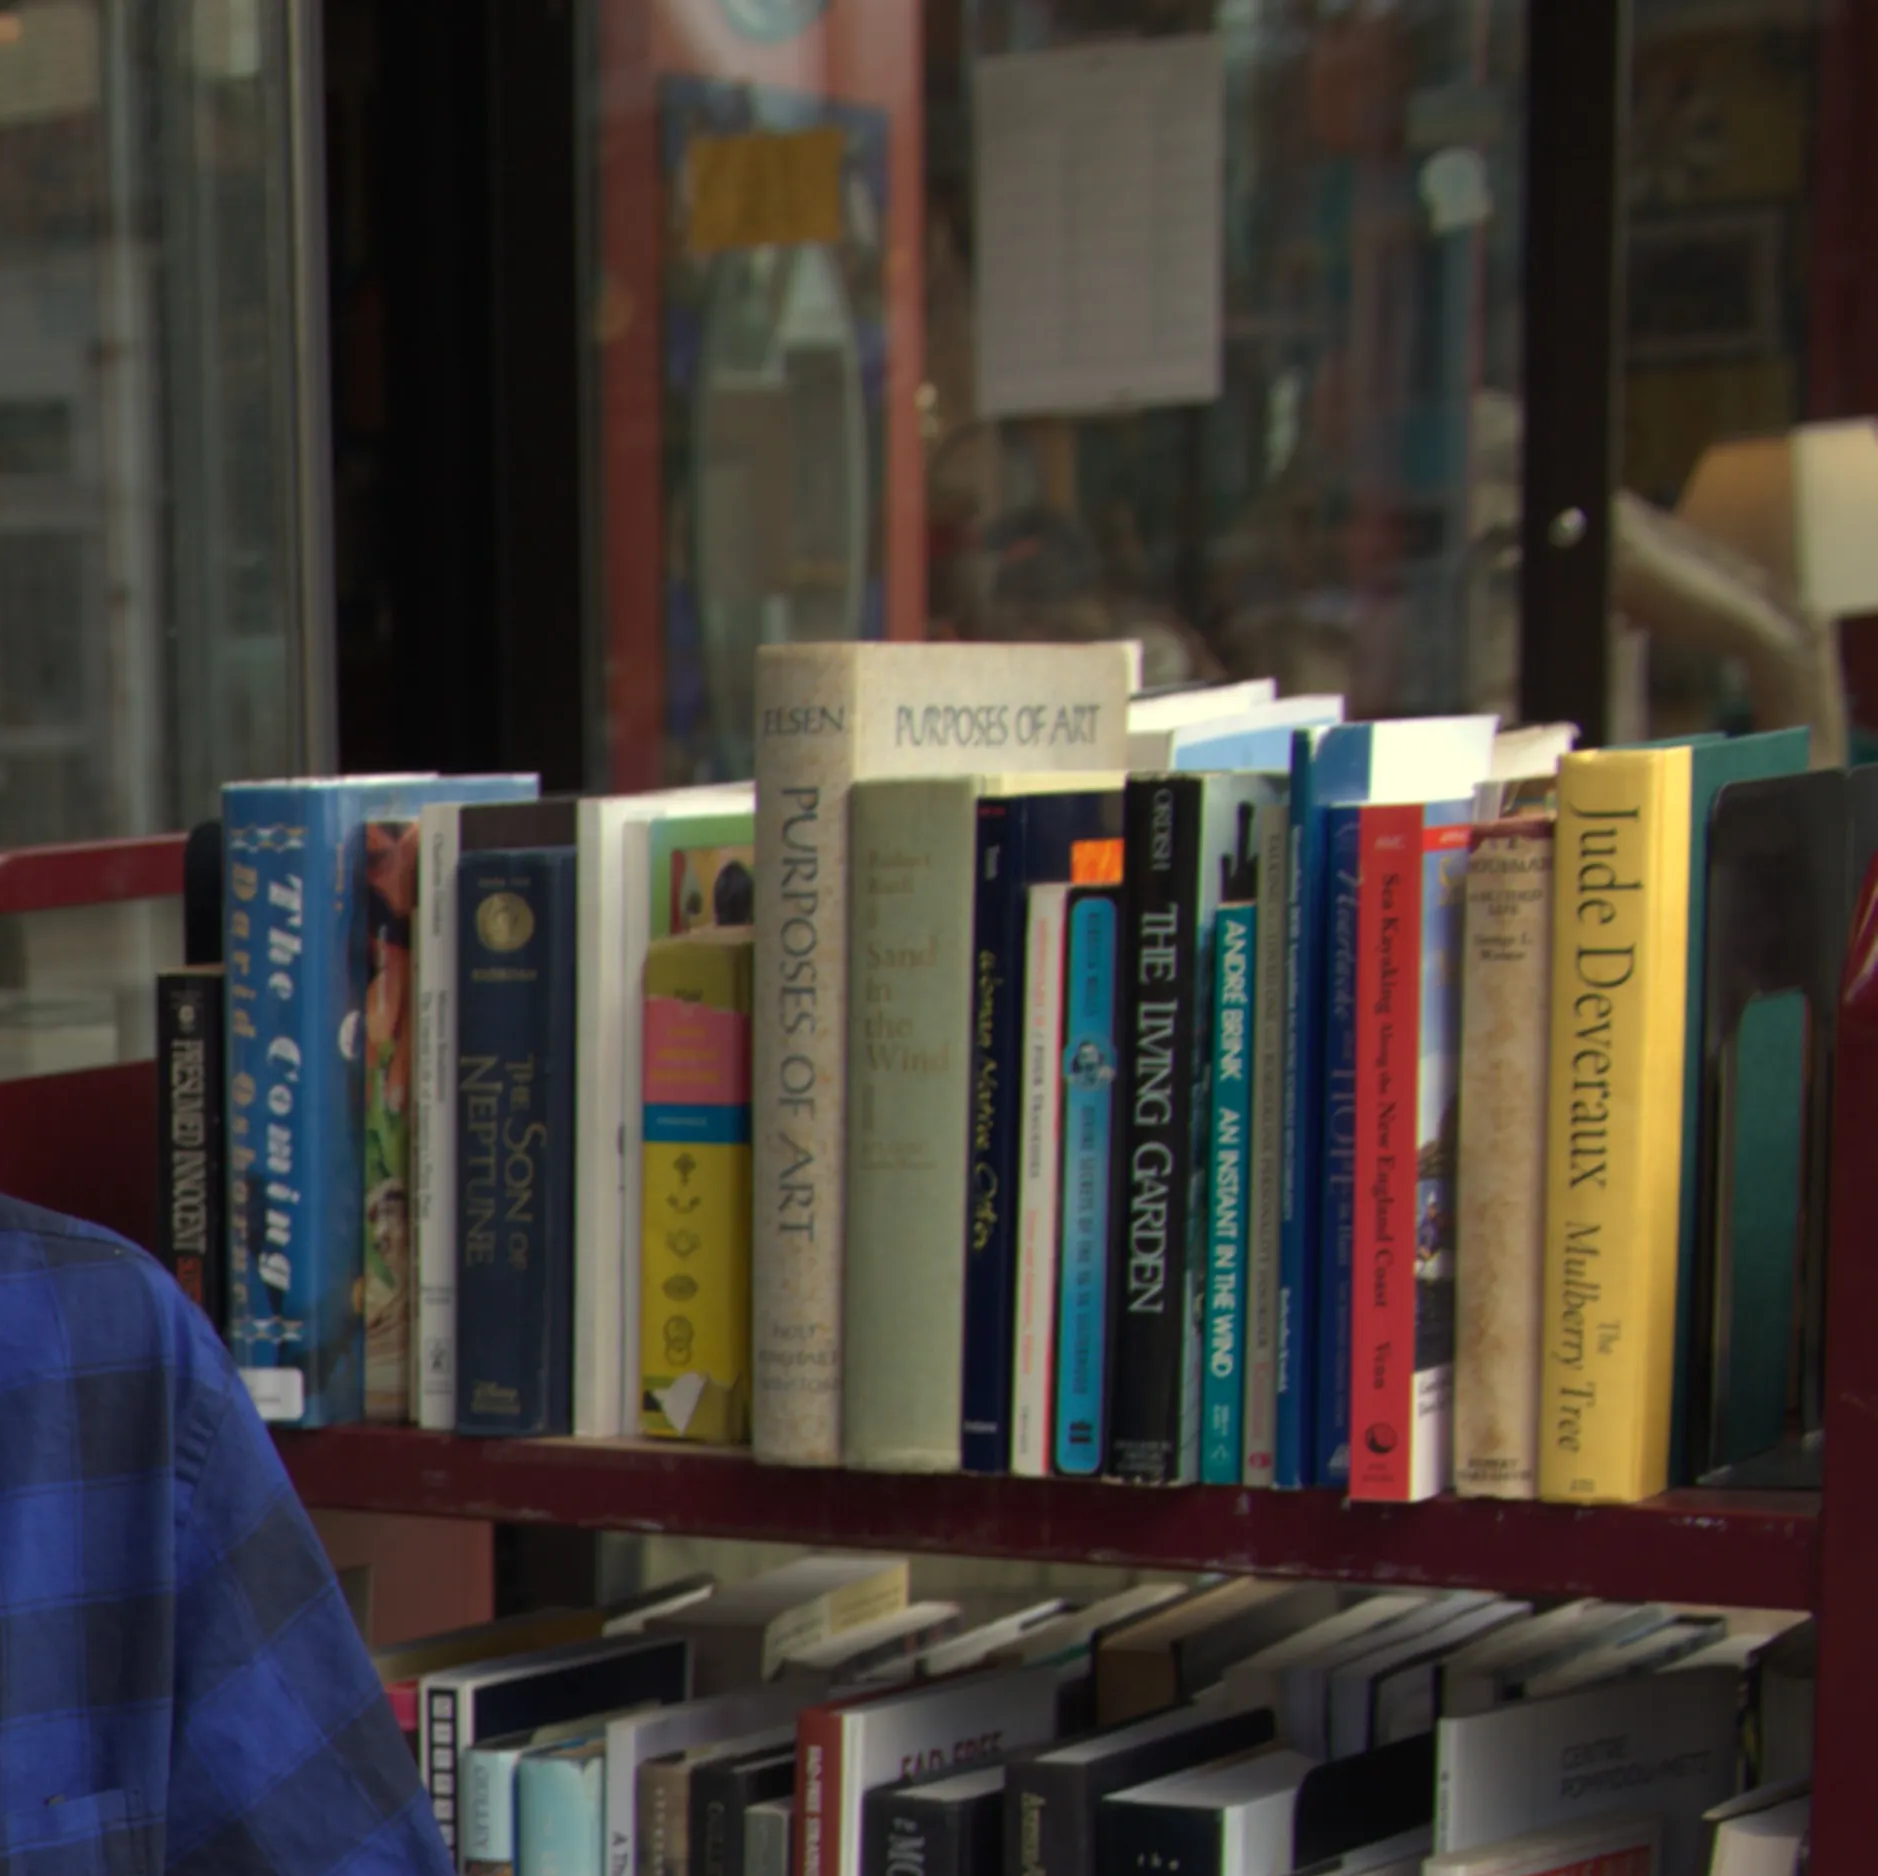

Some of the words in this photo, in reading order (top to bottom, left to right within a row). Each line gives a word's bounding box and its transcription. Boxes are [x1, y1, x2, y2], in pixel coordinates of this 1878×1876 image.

[763, 706, 844, 738] ELSEN
[895, 704, 1009, 746] PURPOSES
[1016, 704, 1047, 745] OF
[1049, 704, 1101, 745] ART
[1381, 873, 1400, 909] Sea
[1567, 803, 1646, 926] Jude
[266, 874, 304, 999] The
[780, 785, 819, 1034] PURPOSES
[1139, 903, 1180, 984] THE
[229, 861, 258, 1041] David
[866, 934, 939, 970] Sand
[1219, 920, 1247, 1002] ANDRÉ
[1375, 916, 1399, 1014] Kayaking
[866, 973, 892, 1003] in
[866, 1008, 913, 1038] the
[505, 1054, 535, 1111] THE
[867, 1041, 950, 1072] Wind
[1134, 998, 1179, 1125] LIVING
[1220, 1010, 1244, 1082] BRINK
[1568, 944, 1639, 1190] Deveraux
[171, 1040, 205, 1147] PRESUMED
[780, 1055, 818, 1119] OF
[1217, 1107, 1239, 1131] AN
[1379, 1071, 1391, 1095] the
[1378, 1101, 1399, 1149] New
[229, 1072, 257, 1305] Osborne
[257, 1036, 302, 1293] Coming
[458, 1056, 504, 1268] NEPTUNE
[503, 1118, 547, 1221] SON
[779, 1131, 818, 1242] ART
[1214, 1150, 1240, 1239] INSTANT
[170, 1150, 206, 1254] INNOCENT
[1127, 1141, 1174, 1315] GARDEN
[1372, 1155, 1396, 1243] England
[506, 1231, 530, 1271] OF
[1214, 1245, 1237, 1267] IN
[1373, 1248, 1394, 1310] Coast
[1213, 1274, 1237, 1310] THE
[1550, 1221, 1602, 1370] Mulberry
[1210, 1313, 1234, 1378] WIND
[1596, 1320, 1623, 1355] The
[1556, 1381, 1599, 1454] Tree
[611, 1832, 629, 1847] A
